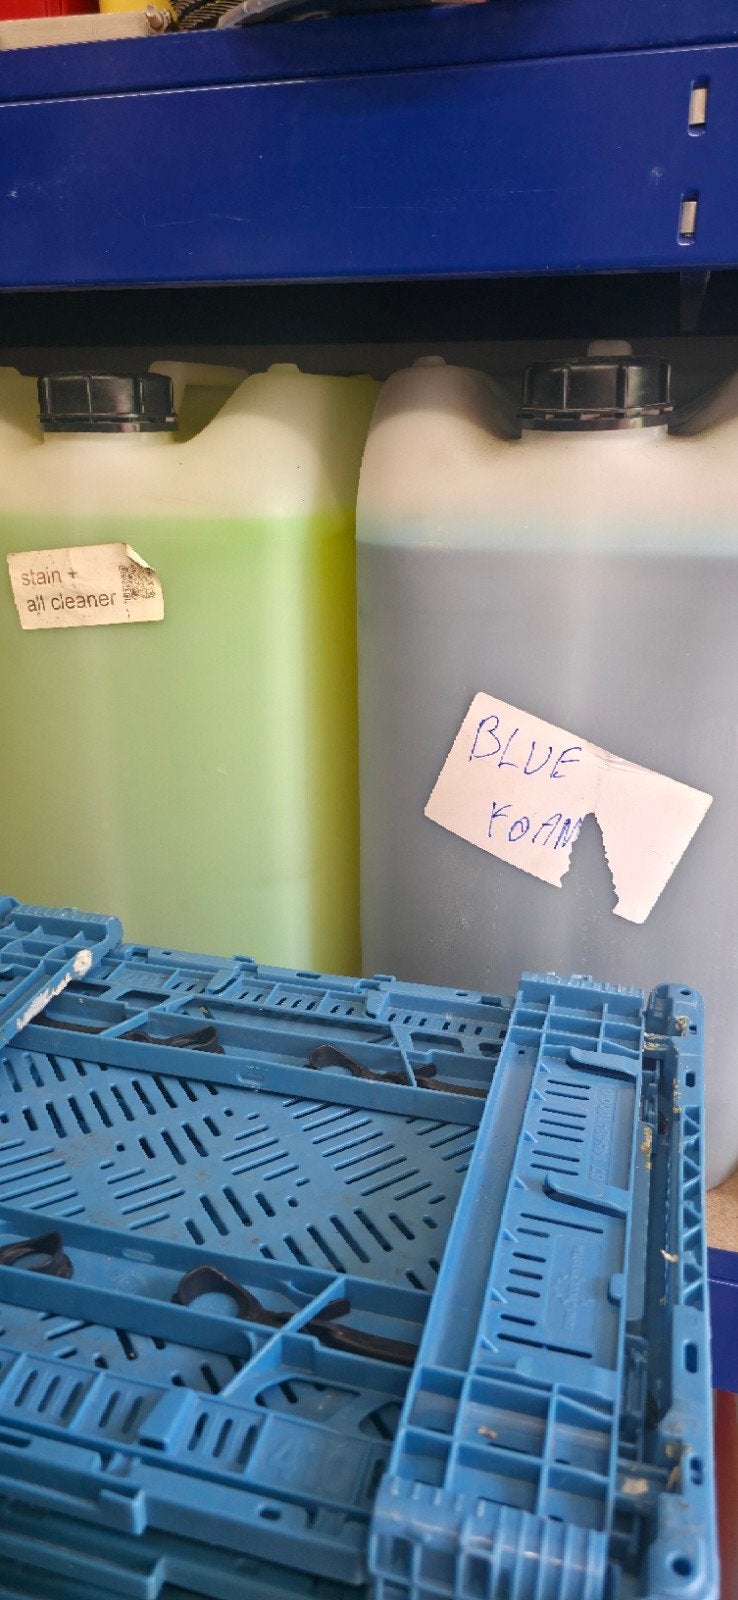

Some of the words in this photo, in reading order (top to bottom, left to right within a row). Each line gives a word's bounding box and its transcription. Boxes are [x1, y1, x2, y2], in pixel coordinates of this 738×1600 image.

[21, 566, 62, 587] stain
[68, 566, 78, 579] +
[27, 595, 46, 612] all
[51, 592, 117, 611] cleaner
[468, 714, 582, 778] BLUE
